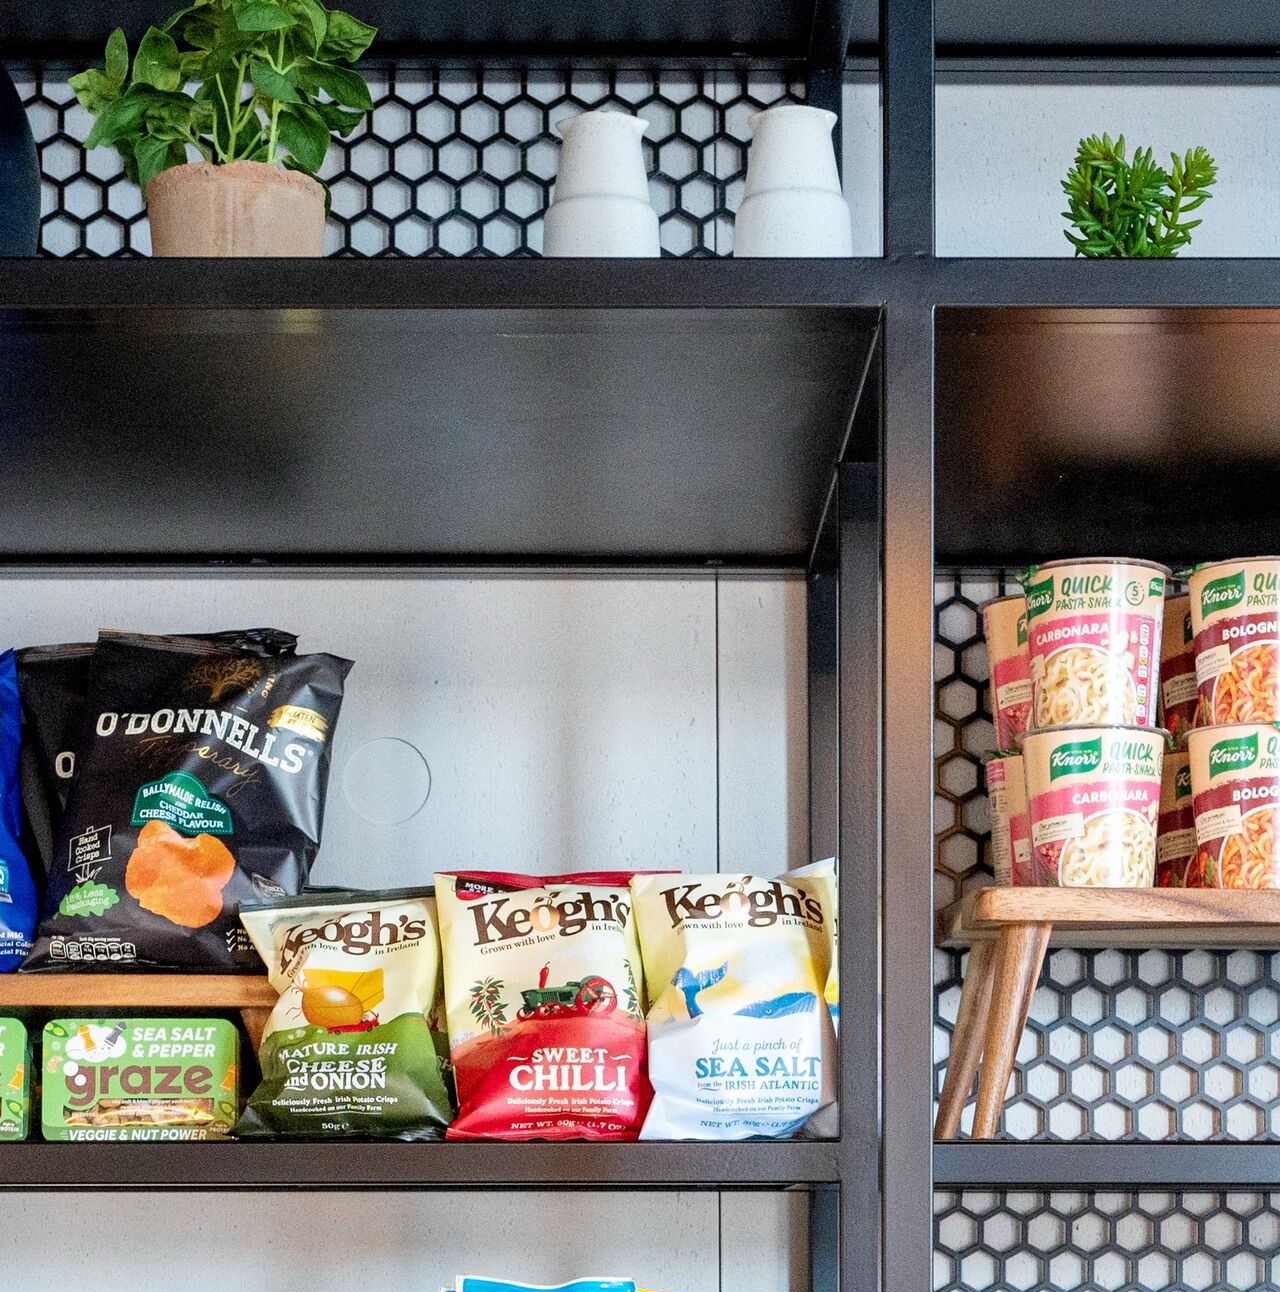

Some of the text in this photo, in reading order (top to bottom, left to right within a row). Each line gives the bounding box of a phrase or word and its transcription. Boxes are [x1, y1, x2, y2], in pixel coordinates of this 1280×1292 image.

[1061, 576, 1115, 596] QUICK
[1026, 591, 1053, 610] Knorr
[1202, 586, 1243, 608] Knorr
[1036, 624, 1111, 646] CARBONARA
[96, 708, 305, 775] O'DONNELLS
[1052, 752, 1099, 770] Knorr
[1210, 747, 1255, 764] Knorr
[142, 783, 227, 815] BALLYMALOE RELISH
[1072, 790, 1149, 804] CARBONARA
[139, 809, 225, 830] CHEESE FLAVOUR
[159, 800, 204, 819] CHEDDAR
[659, 881, 824, 929] Keogh's
[467, 891, 631, 947] Keogh's
[480, 933, 556, 956] Grown with love
[132, 1026, 217, 1041] SEA SALT
[131, 1043, 216, 1058] & PEPPER
[279, 1043, 398, 1064] MATURE IRISH
[531, 1047, 609, 1064] SWEET
[286, 1057, 387, 1074] CHEESE
[695, 1056, 822, 1079] SEA SALT
[65, 1062, 213, 1106] graze
[310, 1072, 386, 1091] ONION
[508, 1065, 628, 1092] CHILLI
[724, 1081, 820, 1091] IRISH ATLANTIC
[69, 1129, 207, 1141] VEGGIE & NUT POWER
